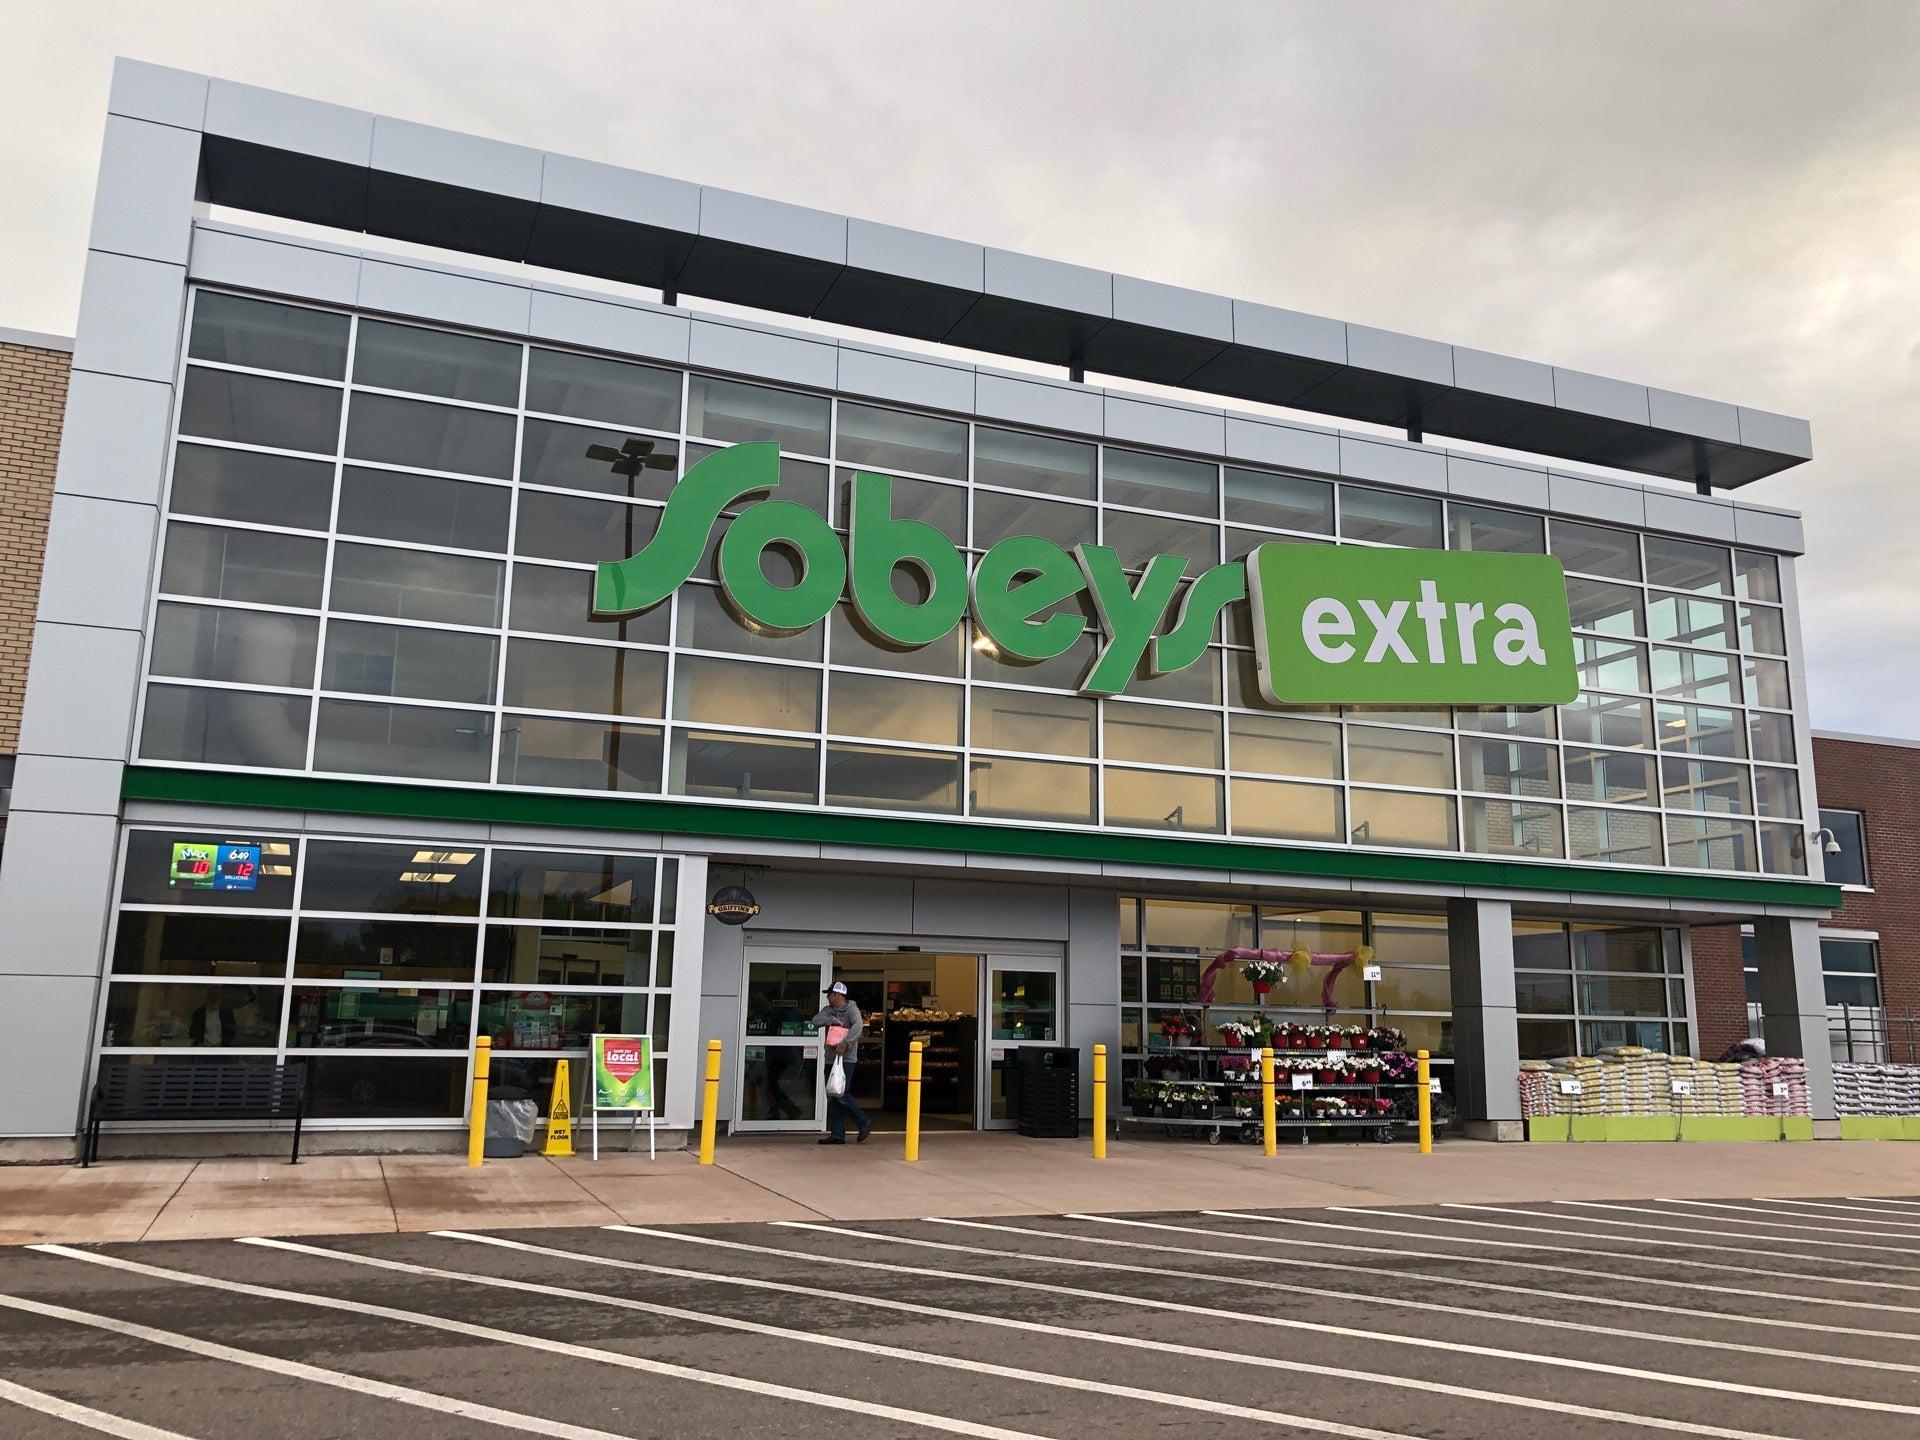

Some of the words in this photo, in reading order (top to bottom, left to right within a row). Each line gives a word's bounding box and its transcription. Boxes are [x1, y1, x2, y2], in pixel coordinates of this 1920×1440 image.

[593, 441, 1245, 694] Sobeys
[1302, 580, 1547, 666] extra
[192, 861, 209, 873] 10
[237, 864, 254, 875] 12
[607, 1051, 639, 1061] local
